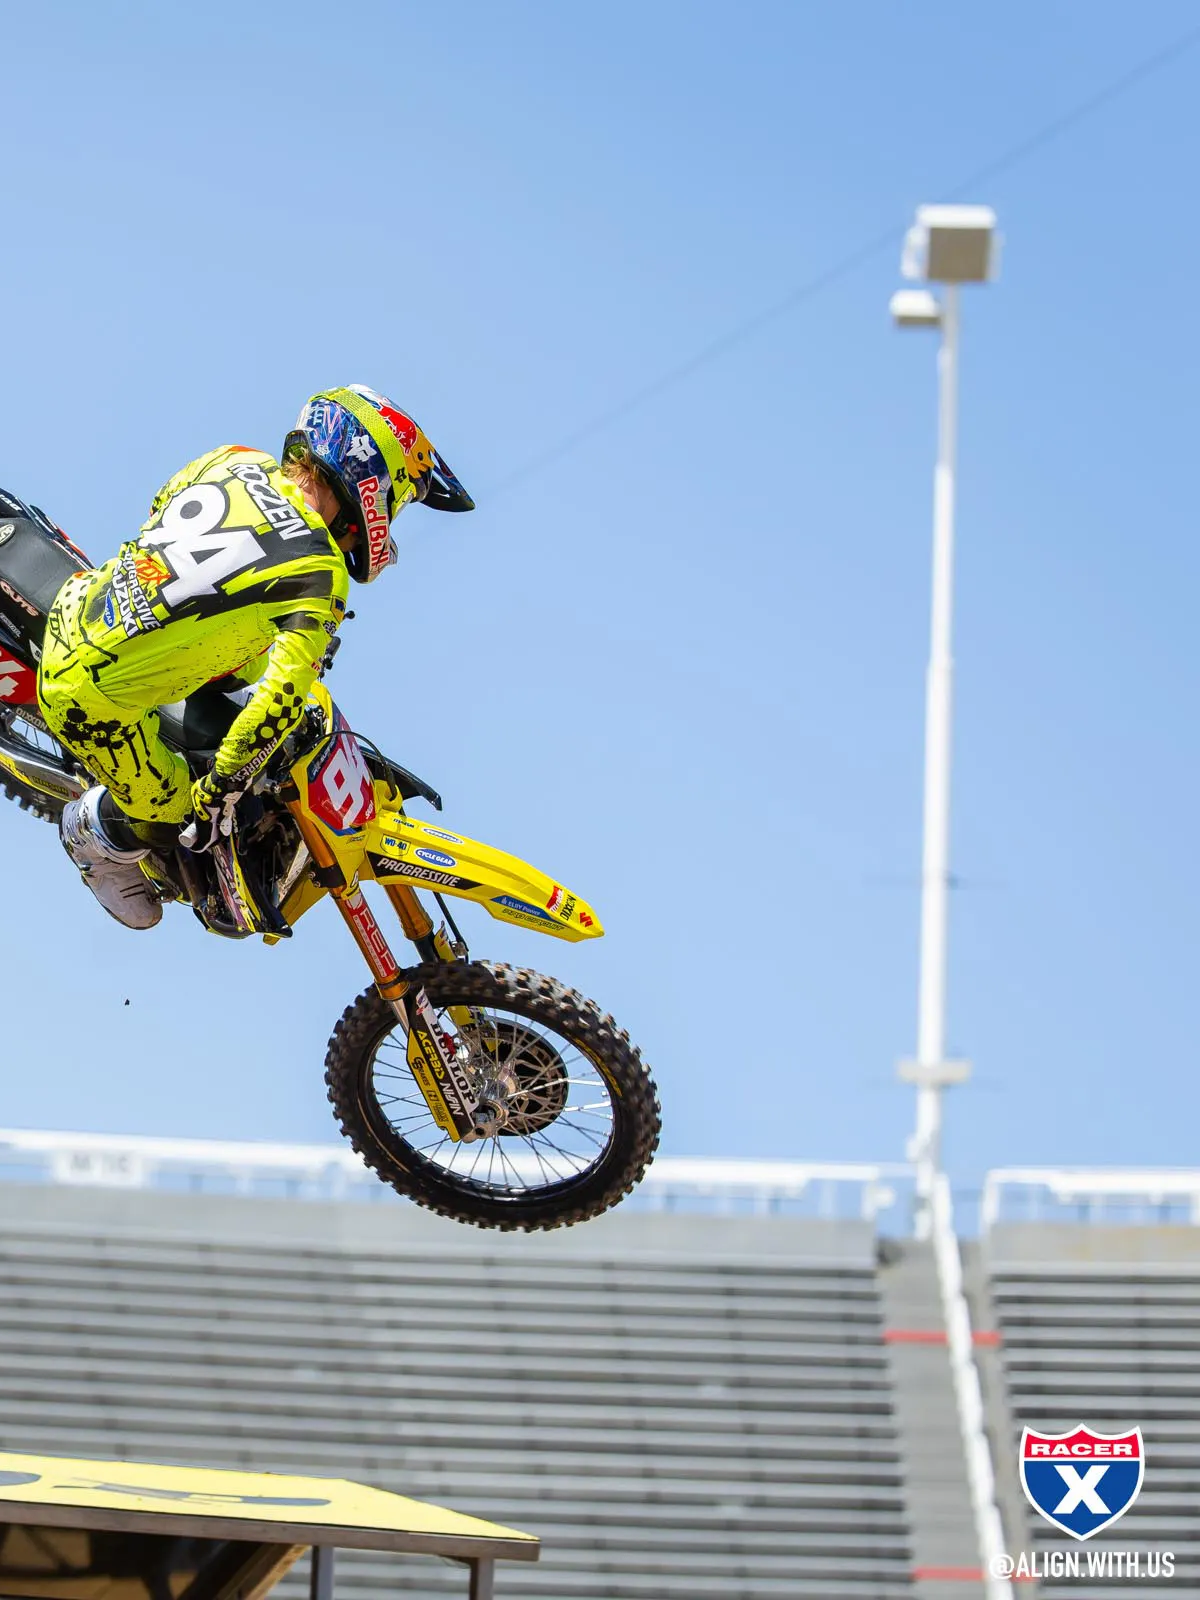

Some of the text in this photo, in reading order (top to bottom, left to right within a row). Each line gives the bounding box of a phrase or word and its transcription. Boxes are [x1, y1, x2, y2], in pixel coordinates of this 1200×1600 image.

[227, 463, 312, 541] ROCZEN
[358, 476, 390, 568] Red Bull
[138, 484, 267, 608] 94
[0, 579, 39, 616] GUTS
[113, 559, 140, 637] SUZUKI
[322, 727, 371, 829] 94
[377, 857, 460, 887] PROGRESSIVE
[385, 837, 407, 850] WD-40
[417, 848, 453, 865] CYCLE GEAR
[431, 1023, 476, 1104] DUNLOP
